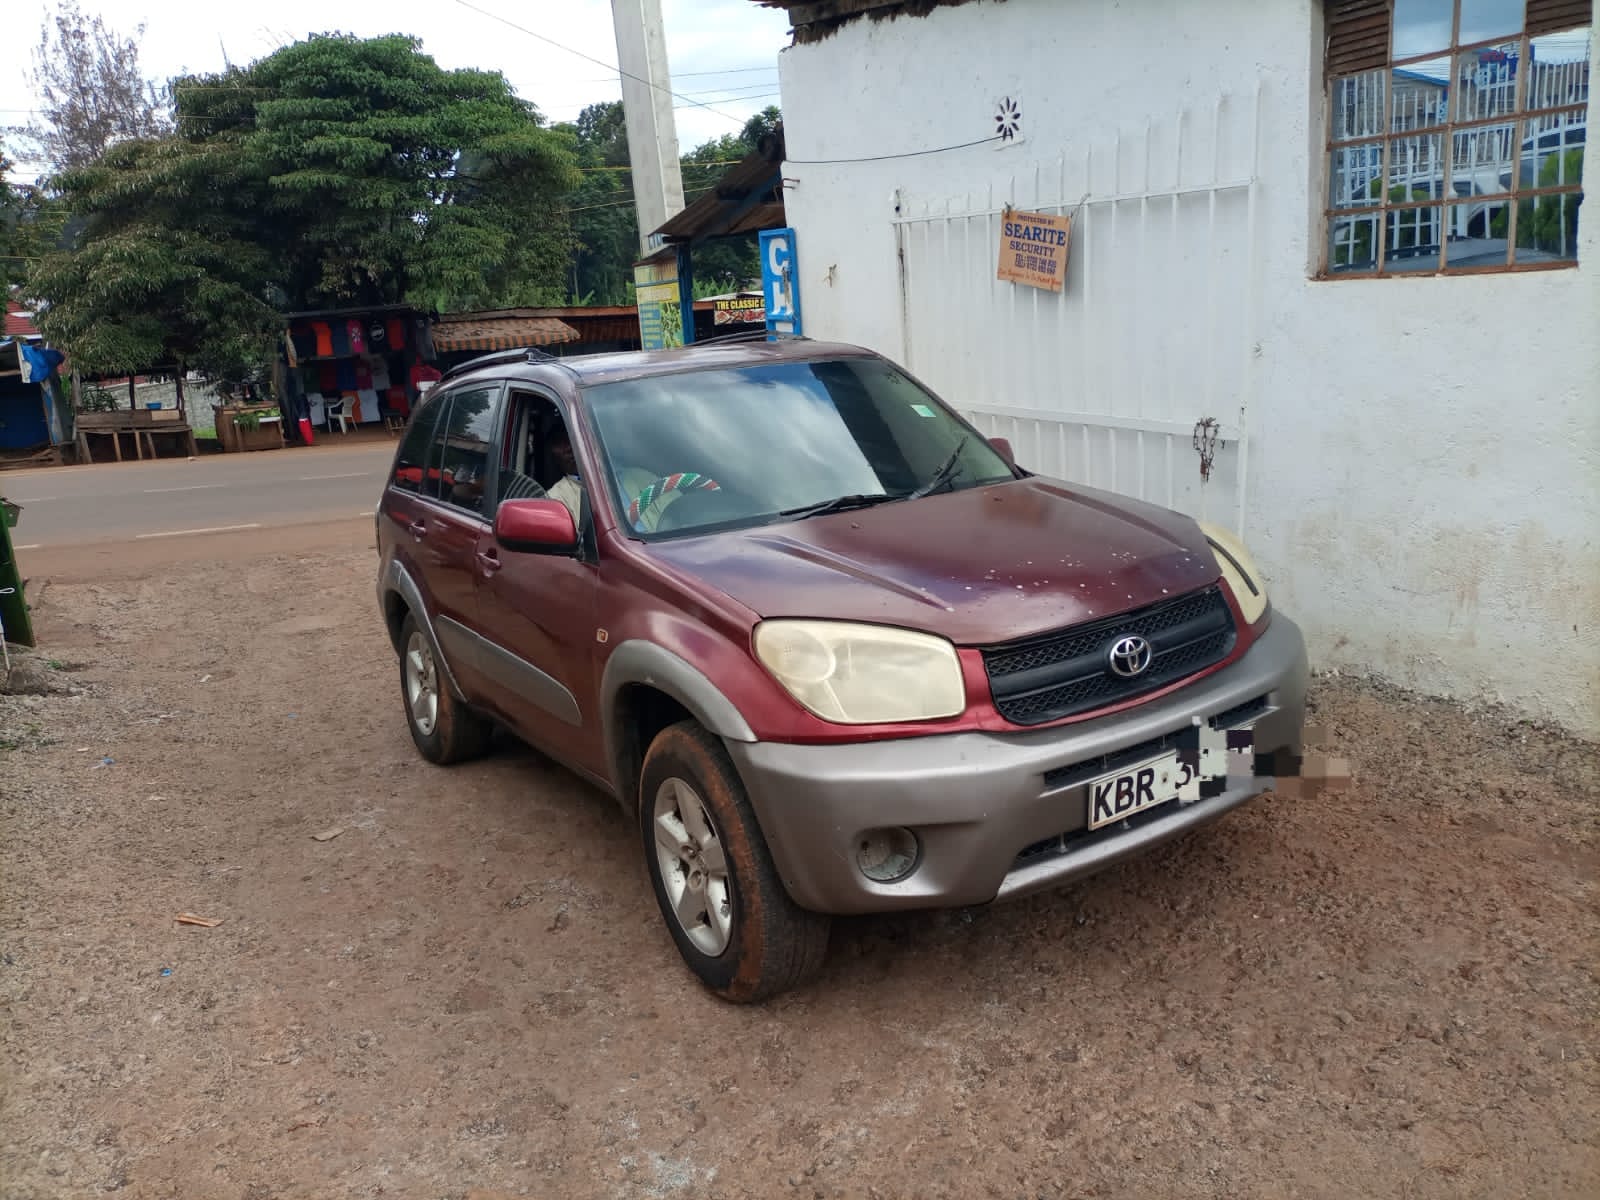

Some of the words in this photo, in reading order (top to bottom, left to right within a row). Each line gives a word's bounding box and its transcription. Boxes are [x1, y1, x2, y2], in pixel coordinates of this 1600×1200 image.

[1005, 222, 1066, 246] SEARITE
[1010, 240, 1055, 257] SECURITY
[716, 300, 730, 310] THE
[730, 299, 760, 309] CLASSIC
[1094, 768, 1154, 822] KBR
